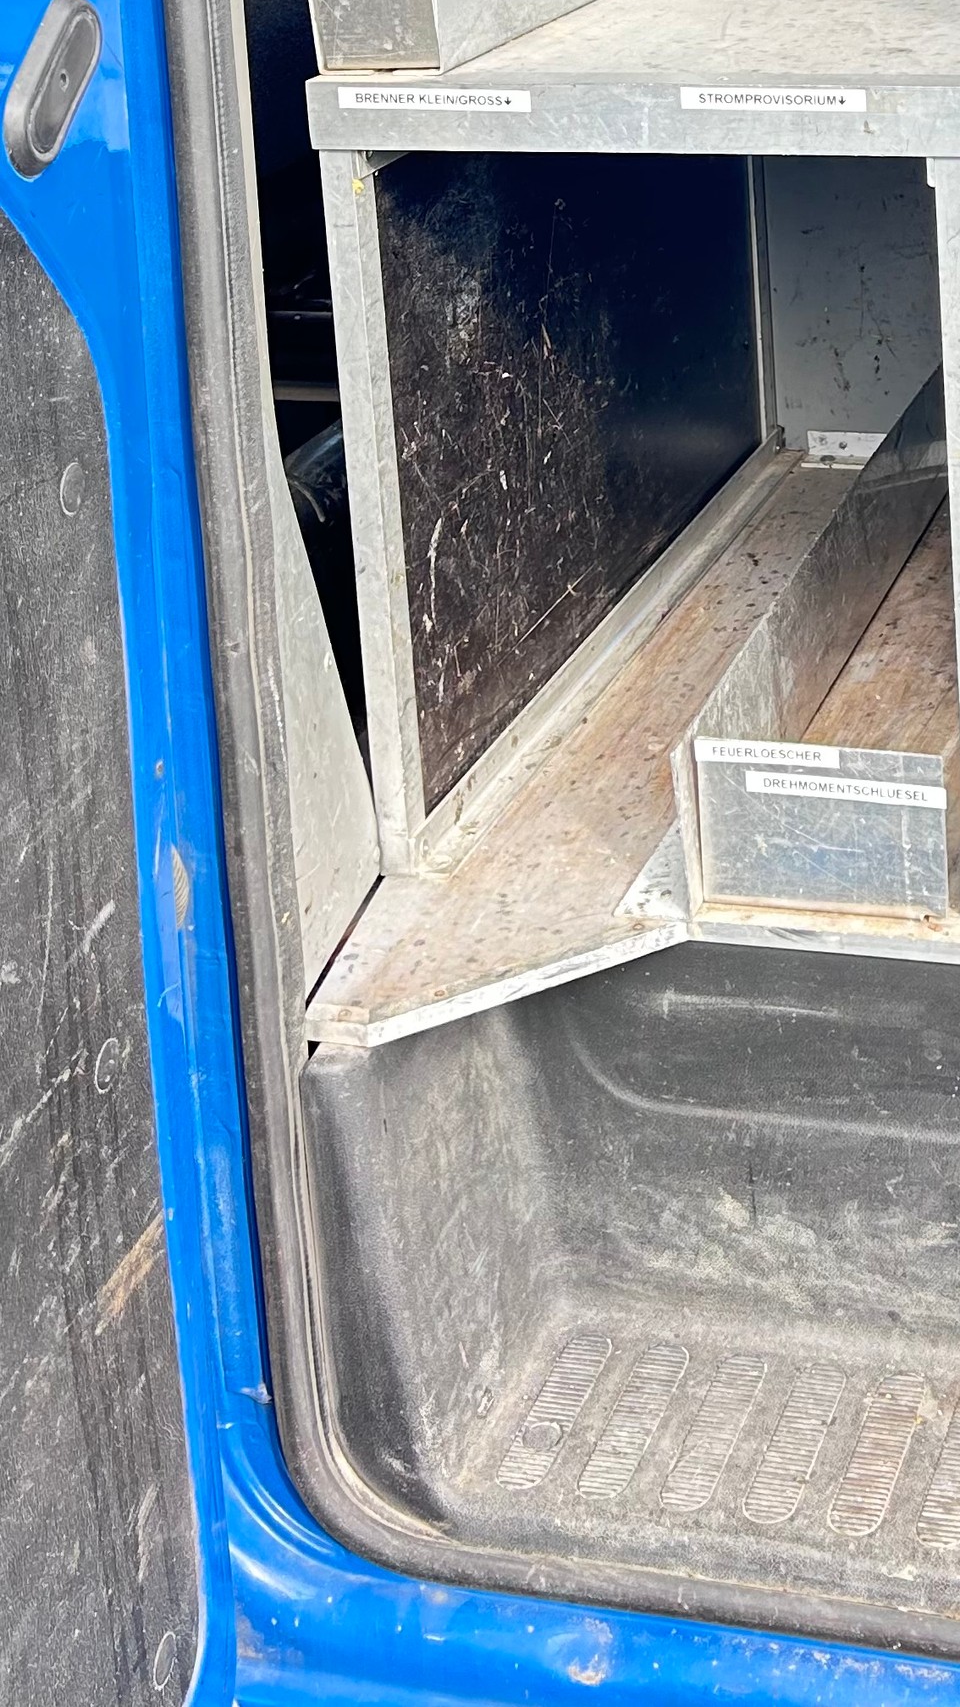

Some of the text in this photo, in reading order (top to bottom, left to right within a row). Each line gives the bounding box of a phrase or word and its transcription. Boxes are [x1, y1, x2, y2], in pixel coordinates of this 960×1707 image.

[355, 93, 503, 106] BRENNER KLEIN/GROSS
[699, 93, 837, 107] STROMPROVISORIUM
[712, 746, 821, 762] FEUERLOESCHER
[763, 777, 928, 802] DREHMOMENTSCHLUESEL
